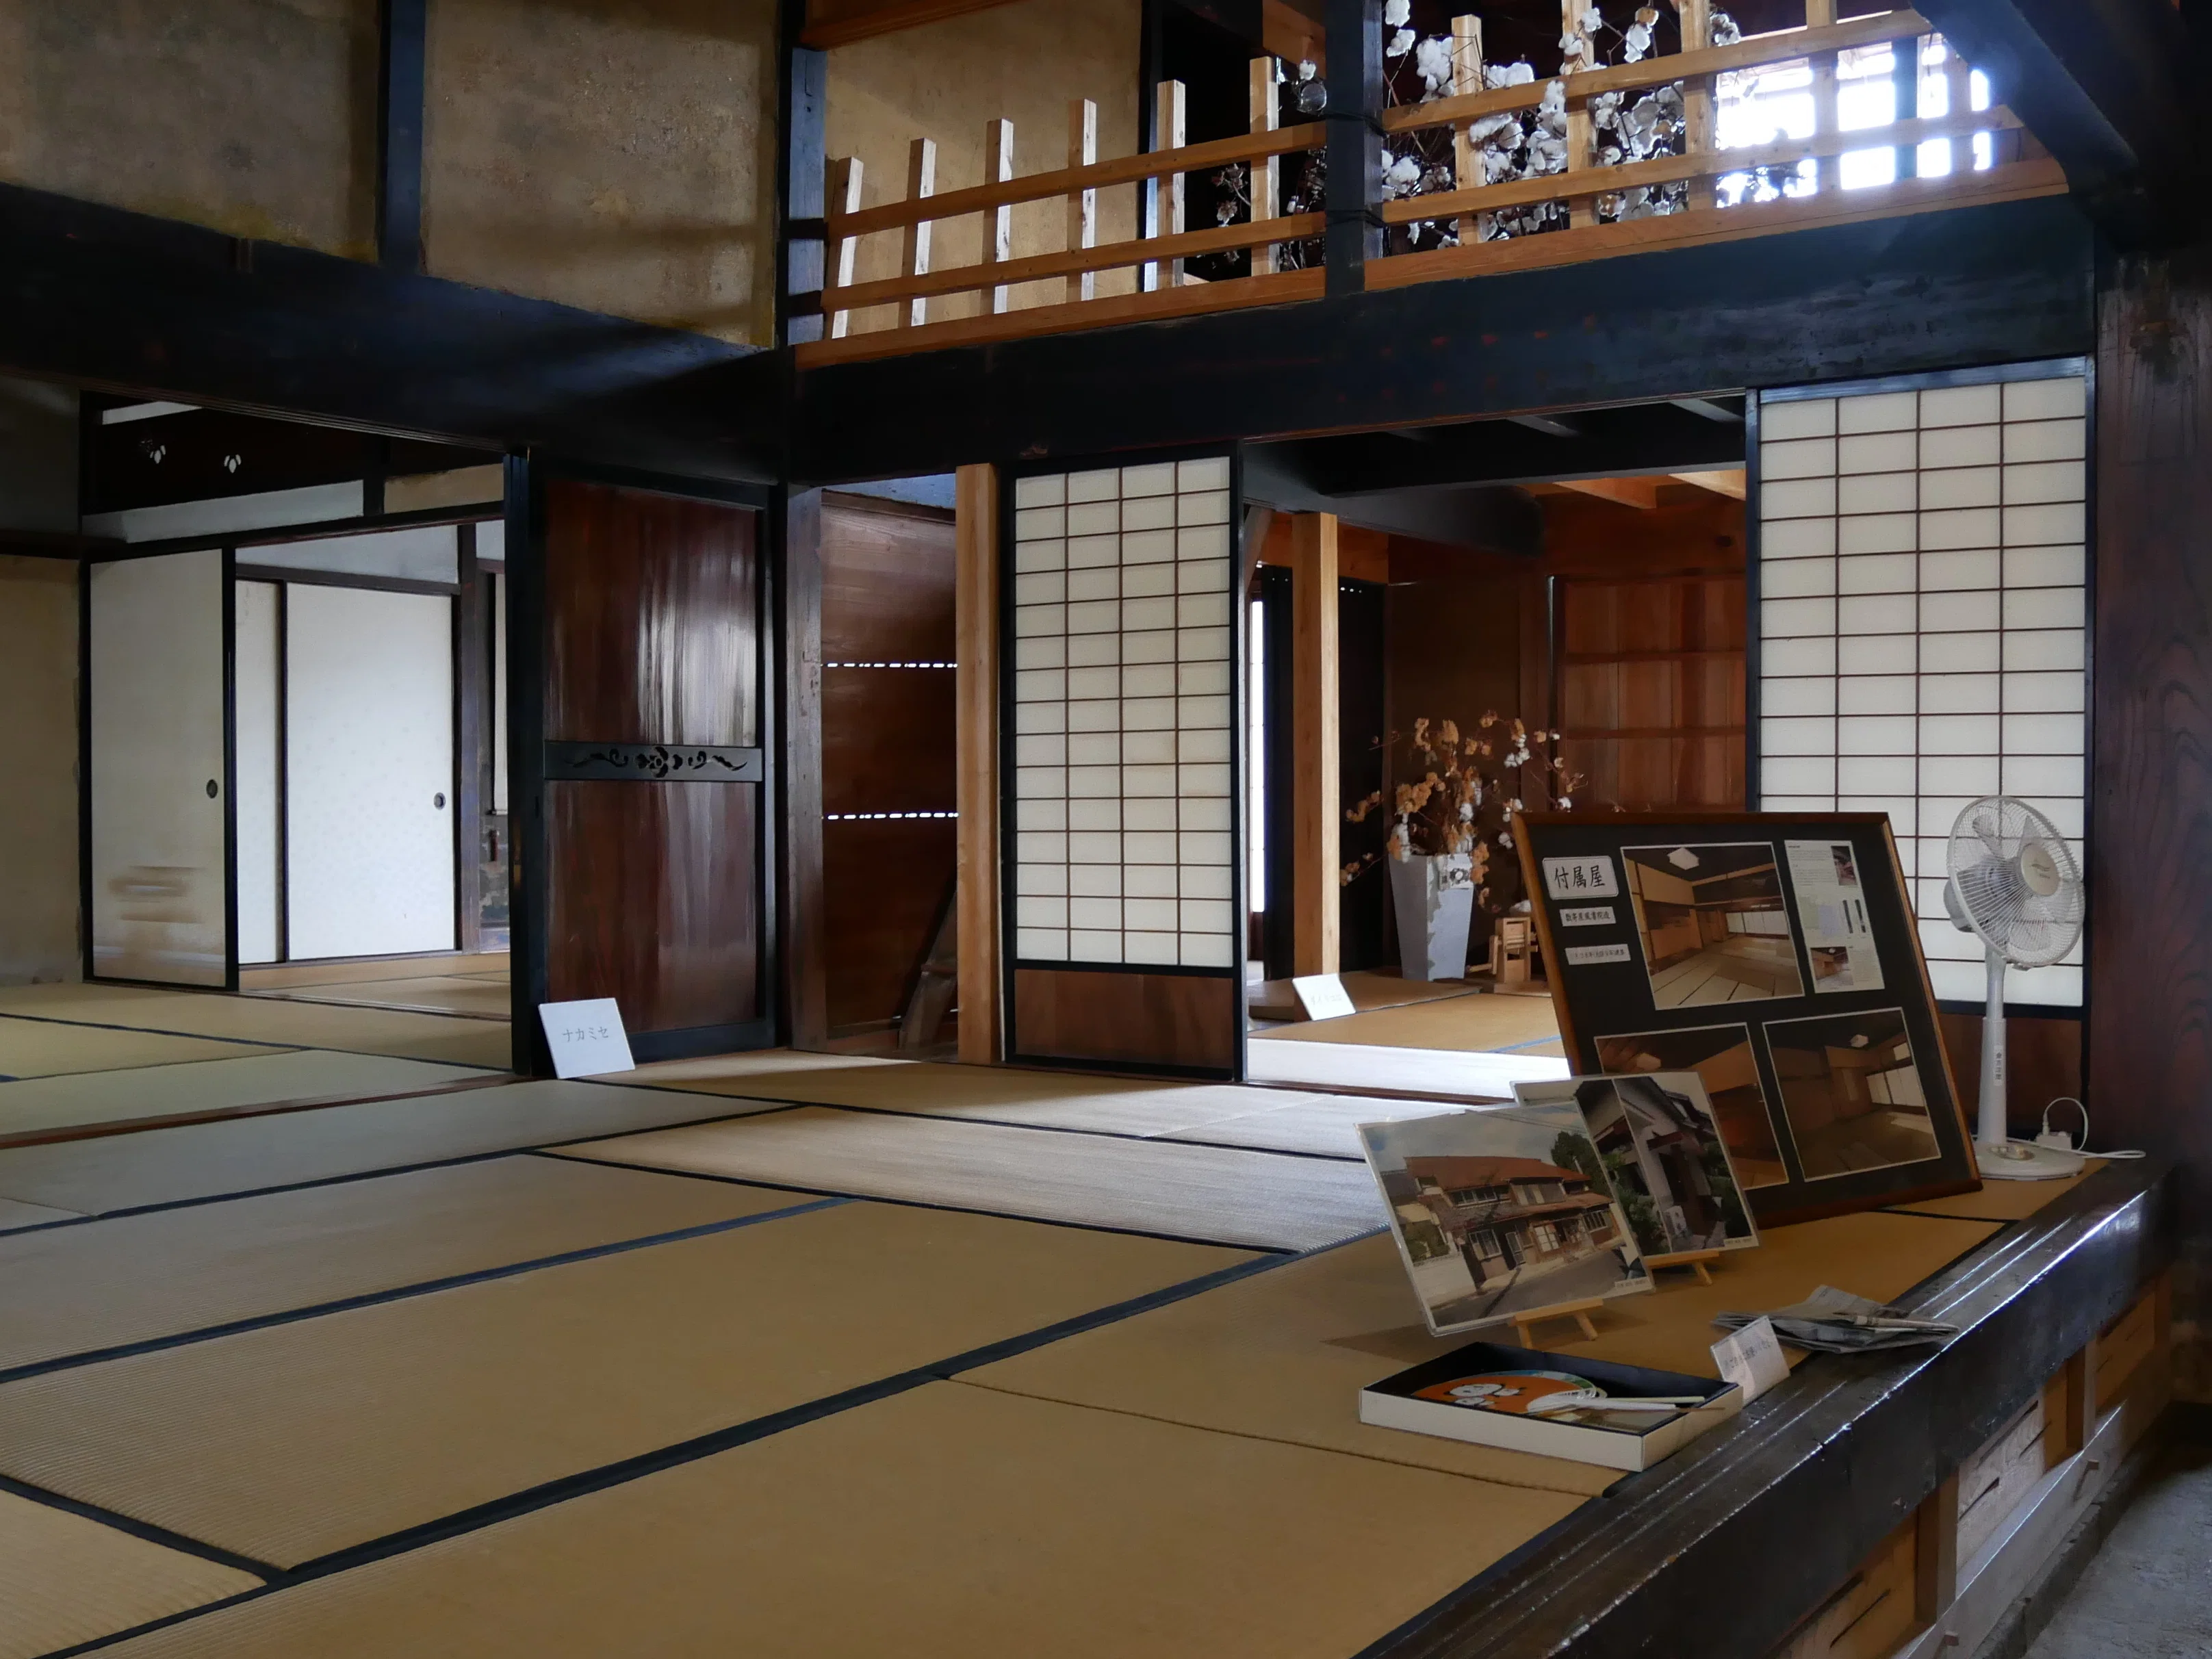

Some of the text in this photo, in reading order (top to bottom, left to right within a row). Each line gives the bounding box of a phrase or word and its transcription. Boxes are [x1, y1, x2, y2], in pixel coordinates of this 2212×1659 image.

[1554, 864, 1606, 890] 付属屋
[563, 1026, 609, 1042] ナカミセ
